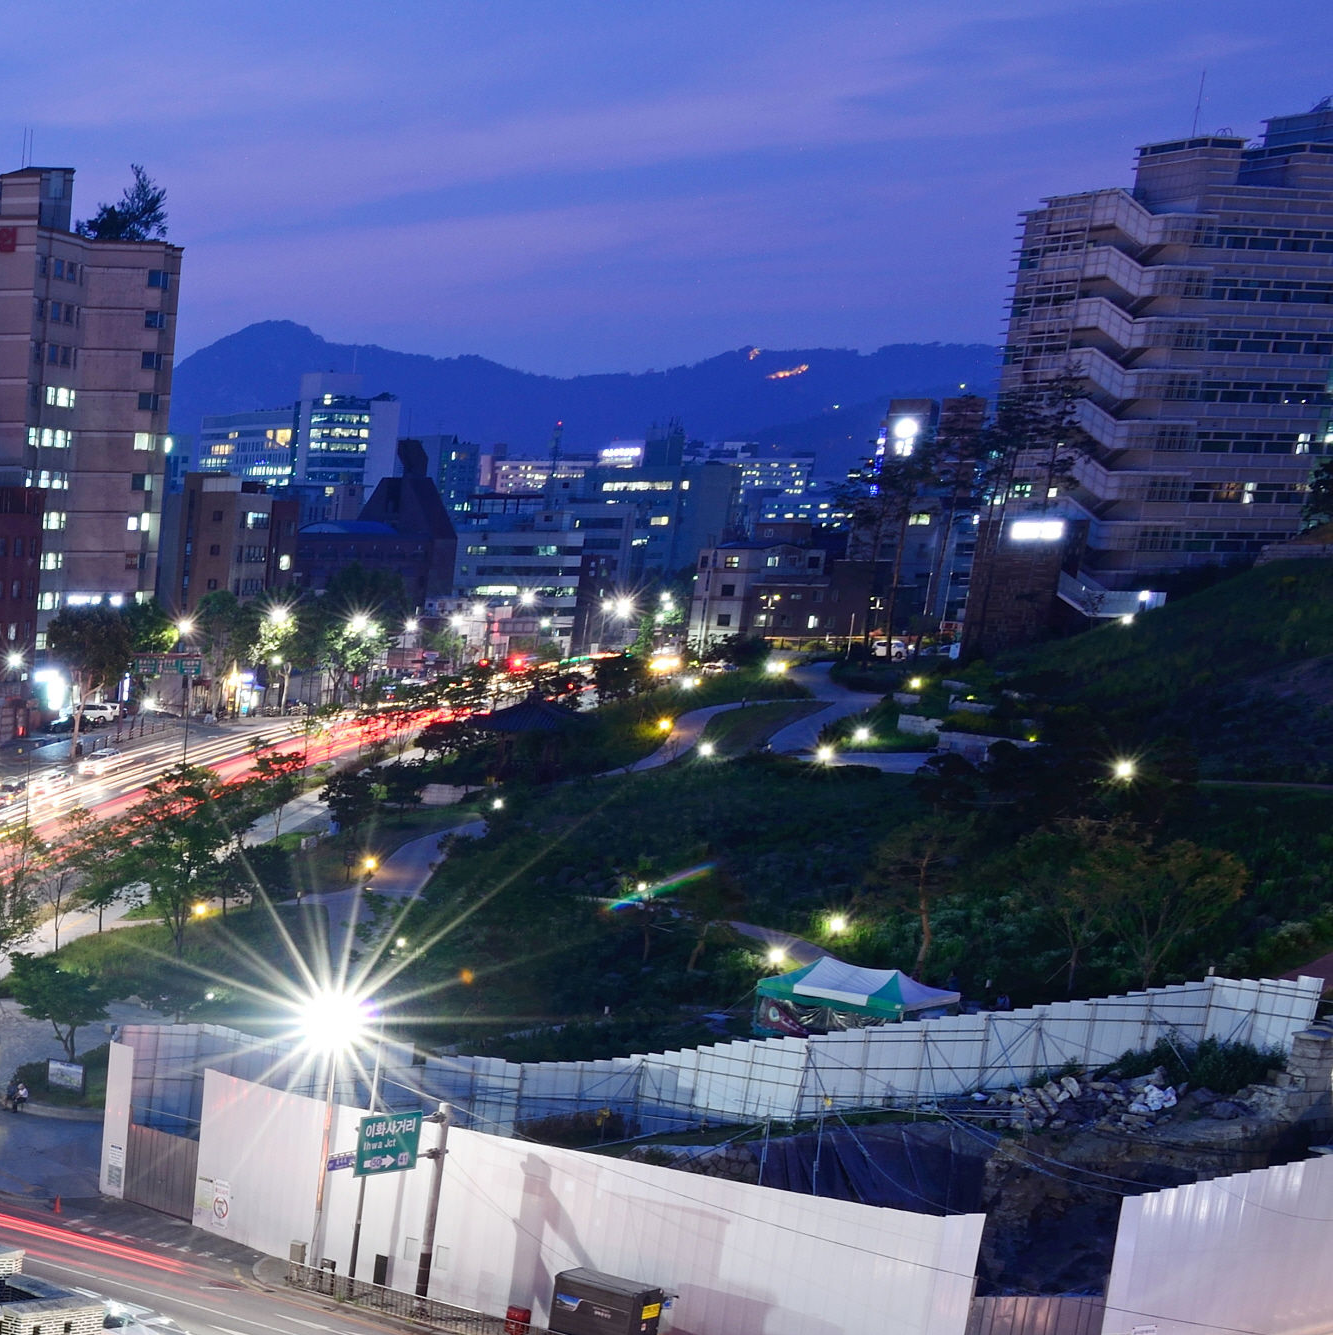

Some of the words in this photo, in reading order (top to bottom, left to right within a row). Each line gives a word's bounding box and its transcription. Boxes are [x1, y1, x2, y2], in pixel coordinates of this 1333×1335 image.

[365, 1118, 417, 1138] 이화사거리
[363, 1141, 383, 1151] Ihwa
[384, 1139, 397, 1149] Jct
